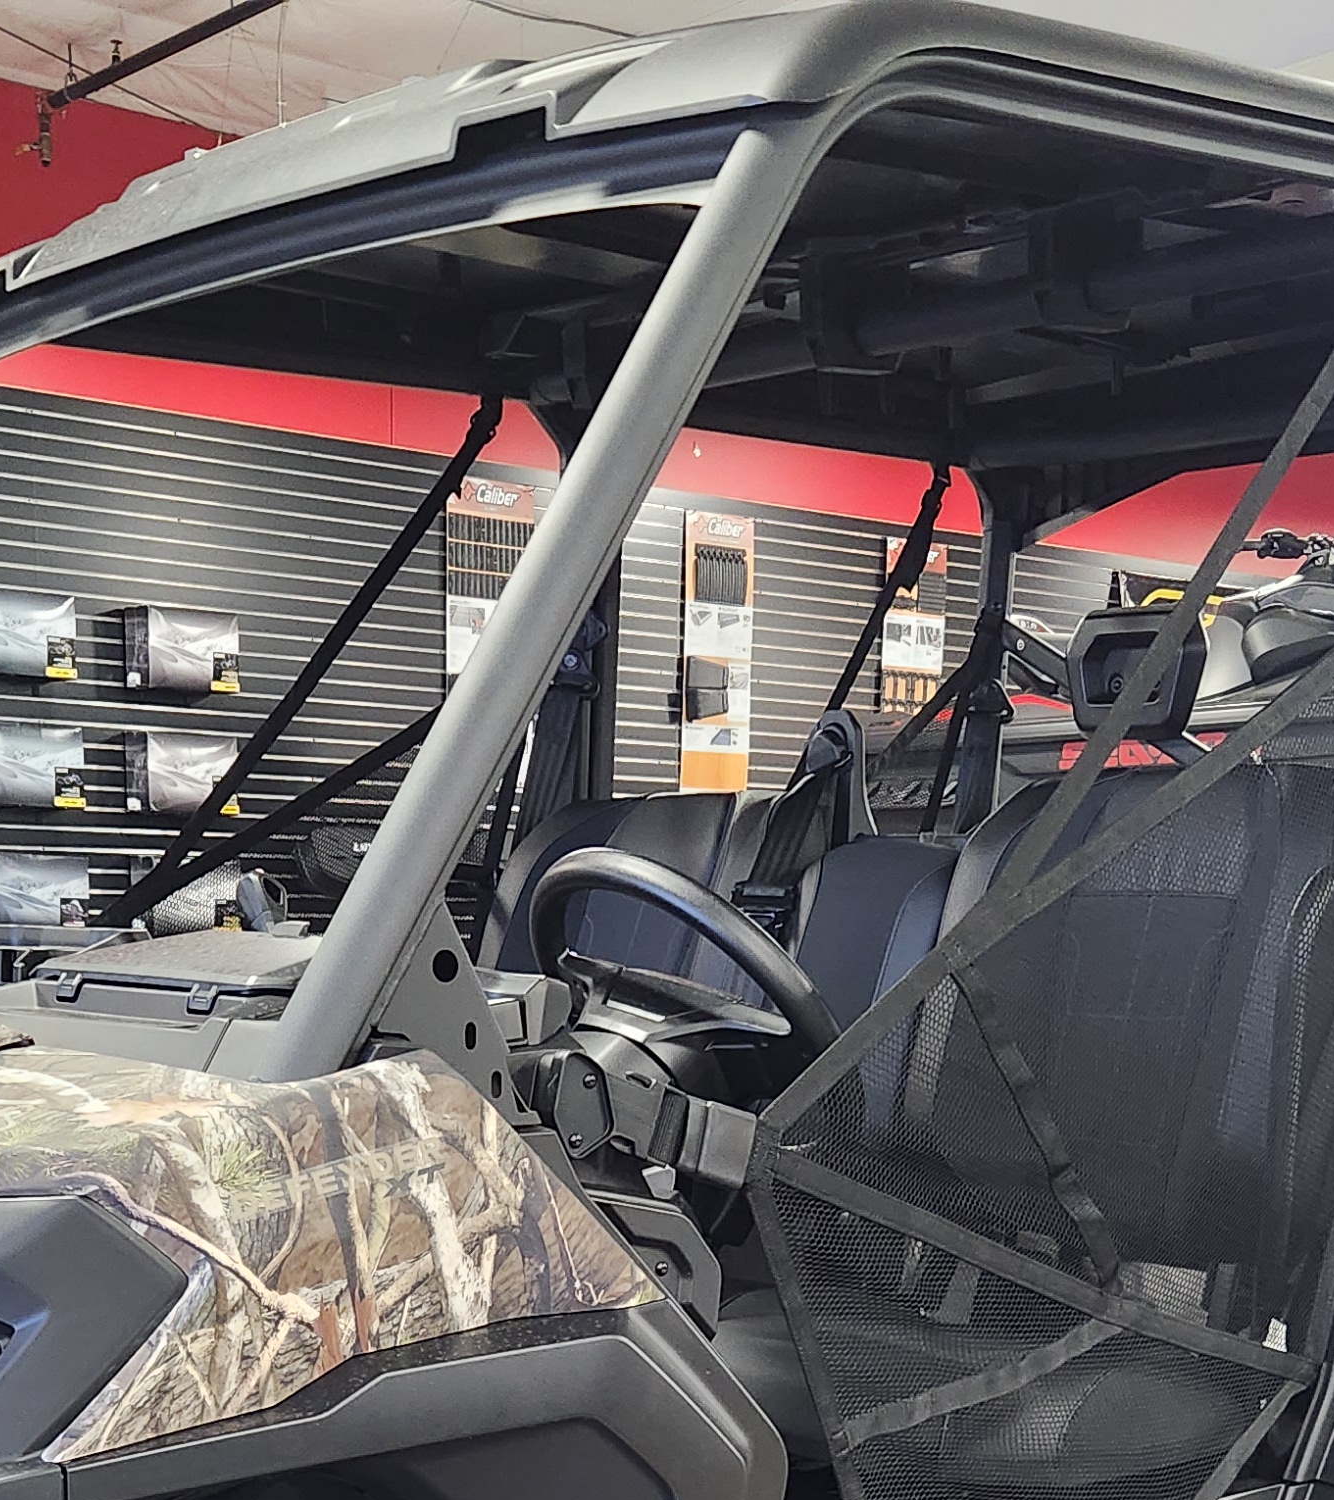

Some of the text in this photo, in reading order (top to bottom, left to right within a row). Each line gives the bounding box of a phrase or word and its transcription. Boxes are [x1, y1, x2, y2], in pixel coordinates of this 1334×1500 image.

[476, 484, 521, 507] Caliber
[707, 517, 746, 538] Caliber
[383, 1162, 446, 1198] XT
